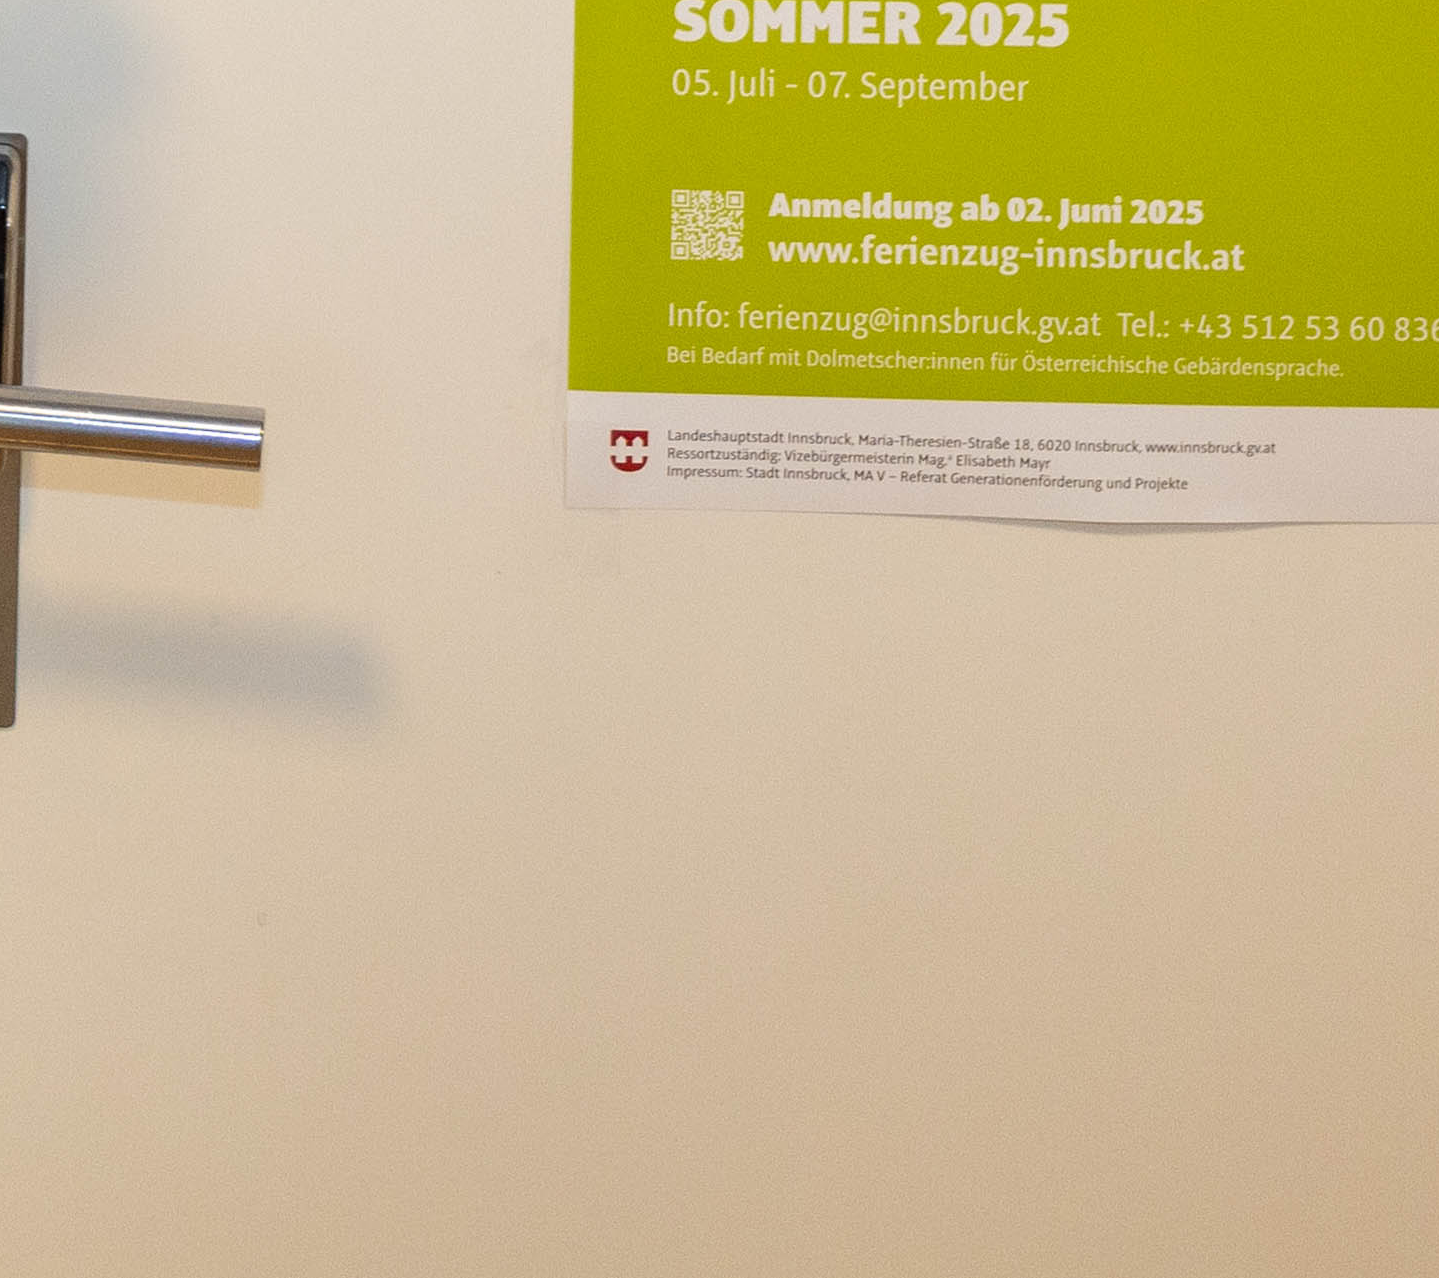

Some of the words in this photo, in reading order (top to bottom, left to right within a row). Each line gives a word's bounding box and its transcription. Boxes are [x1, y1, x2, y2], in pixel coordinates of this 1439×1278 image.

[936, 1, 1070, 47] 2025
[672, 69, 719, 97] 05.
[727, 69, 776, 104] Juli
[808, 72, 850, 98] 07.
[860, 72, 1029, 107] September
[769, 192, 953, 228] Anmeldung
[961, 194, 1000, 222] ab
[1007, 197, 1052, 223] 02.
[1058, 196, 1122, 229] Juni
[1130, 199, 1204, 225] 2025
[768, 235, 1245, 276] www.ferienzug-innsbruck.at
[667, 301, 729, 328] Info:
[738, 302, 1101, 343] ferienzug@innsbruck.gv.at
[1117, 311, 1169, 338] Tel.:
[1179, 314, 1232, 339] +43
[1242, 315, 1294, 340] 512
[1305, 315, 1340, 341] 53
[1349, 316, 1385, 341] 60
[666, 346, 696, 364] Bei
[702, 347, 765, 366] Bedarf
[769, 349, 801, 366] mit
[806, 349, 985, 371] Dolmetscher:innen
[990, 352, 1017, 371] für
[1023, 350, 1168, 374] Österreichische
[1174, 357, 1344, 380] Gebärdensprache.
[668, 430, 784, 444] Landeshauptstadt
[788, 433, 855, 447] Innsbruck,
[859, 435, 1010, 451] Maria-Theresien-Straße
[1014, 438, 1034, 453] 18,
[1037, 439, 1071, 452] 6020
[1075, 440, 1141, 454] Innsbruck,
[1145, 441, 1276, 457] www.innsbruck.gv.at
[668, 448, 781, 463] Ressortzuständig:
[784, 450, 914, 466] Vizebürgermeisterin
[956, 454, 1015, 468] Elisabeth
[1019, 457, 1051, 470] Mayr
[667, 466, 742, 479] Impressum:
[746, 467, 779, 479] Stadt
[783, 468, 850, 482] Innsbruck,
[854, 470, 874, 481] MA
[876, 471, 886, 482] V
[900, 472, 947, 483] Referat
[950, 473, 1102, 492] Generationenförderung
[1106, 478, 1131, 490] und
[1135, 478, 1188, 492] Projekte
